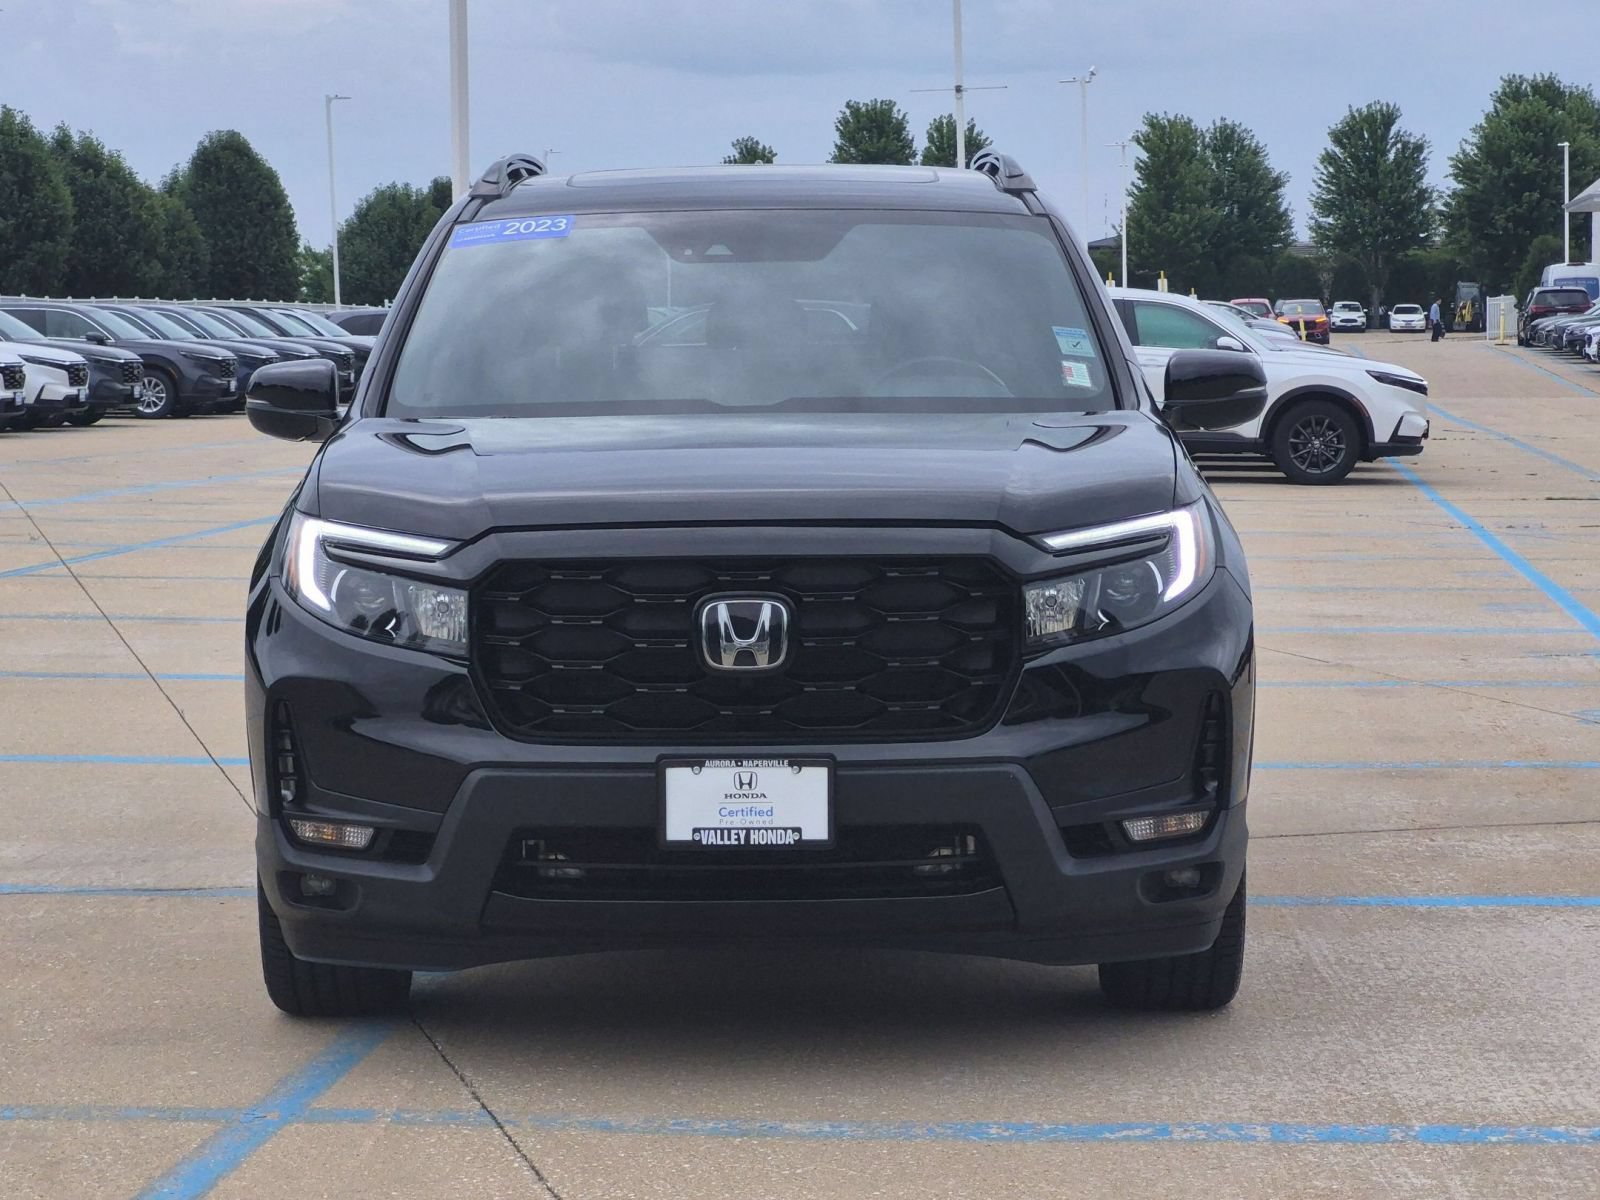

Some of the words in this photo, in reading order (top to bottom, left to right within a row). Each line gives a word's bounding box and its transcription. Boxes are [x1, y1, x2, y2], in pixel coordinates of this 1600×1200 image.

[502, 218, 567, 235] 2023
[704, 759, 736, 768] AURORA
[742, 759, 789, 768] NAPERVILLE
[718, 806, 774, 818] Certified
[700, 829, 747, 845] VALLEY
[750, 829, 795, 845] HONDA
